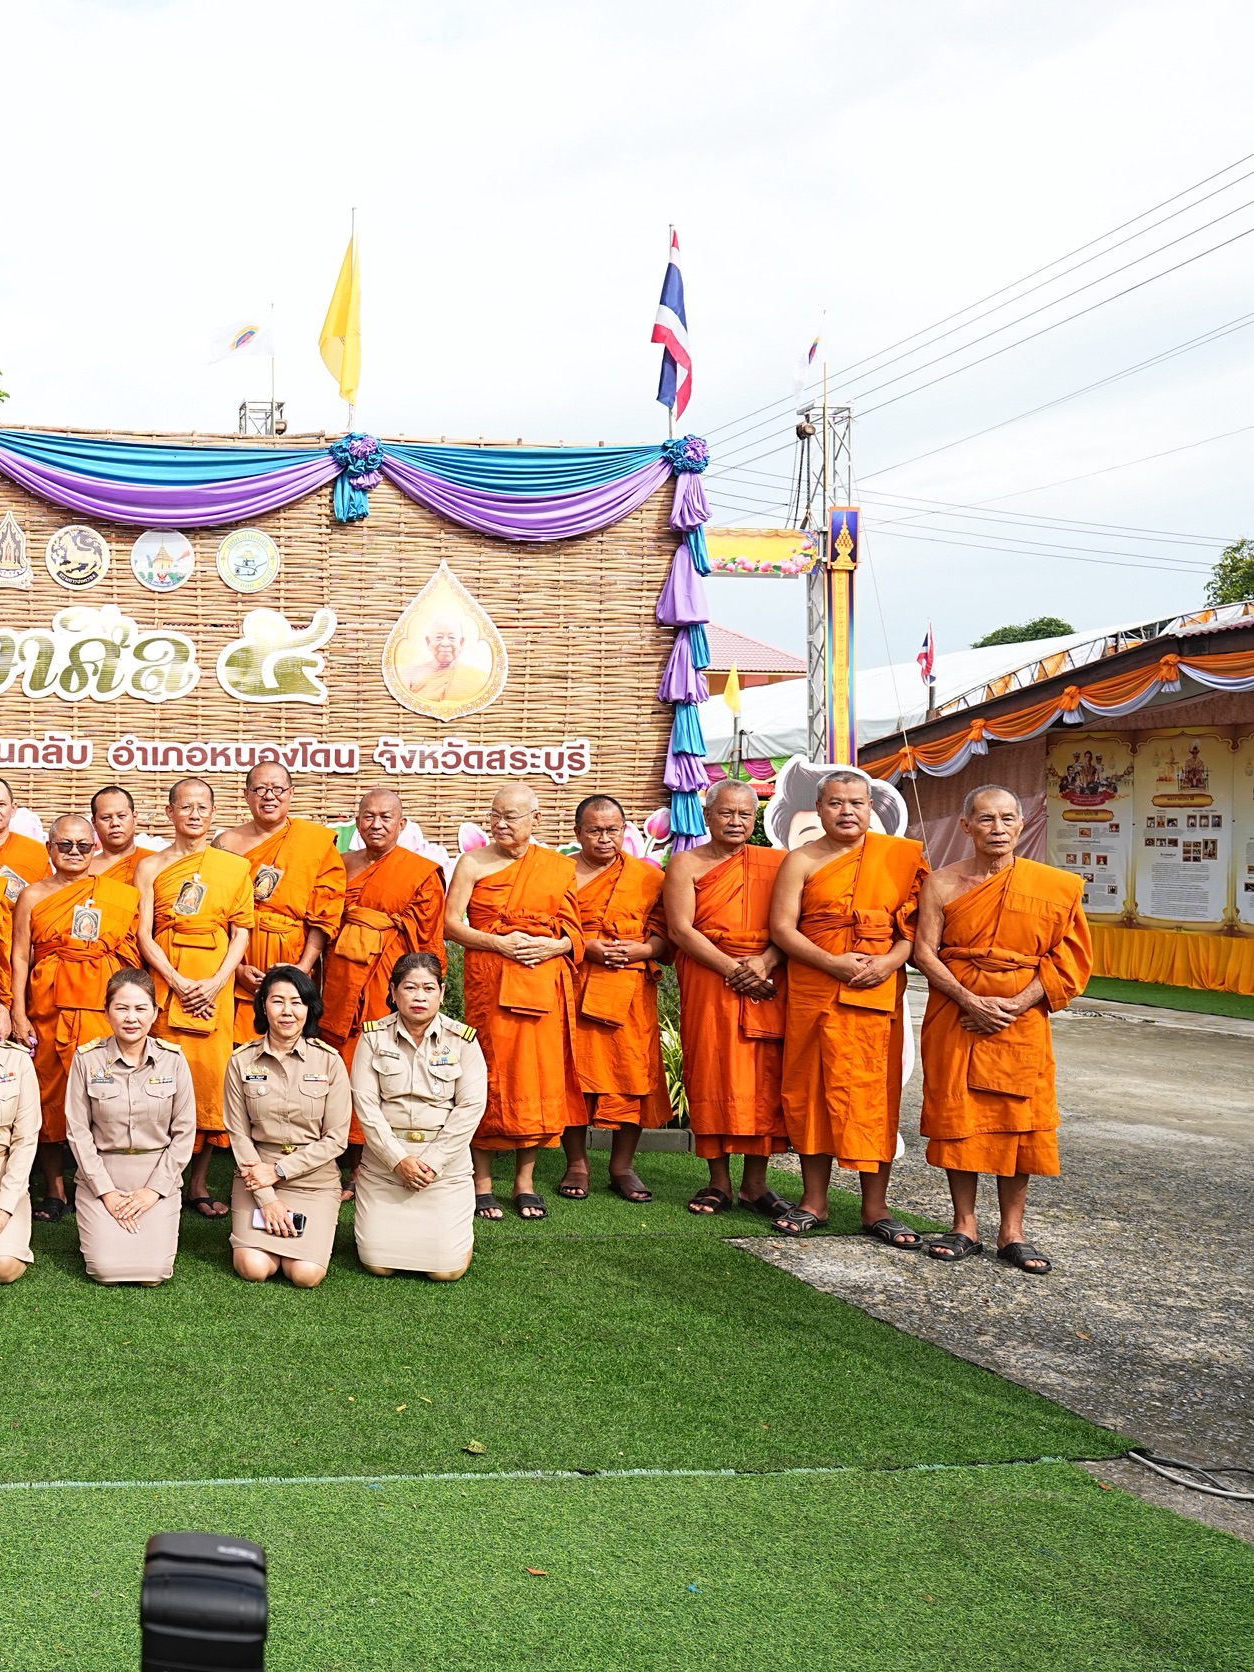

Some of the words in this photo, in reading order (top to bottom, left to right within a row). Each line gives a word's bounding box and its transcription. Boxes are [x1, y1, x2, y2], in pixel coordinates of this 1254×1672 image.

[225, 616, 330, 697] ๕
[112, 739, 355, 768] อำเภอหนองโดน
[378, 741, 586, 779] จังหวัดสระบุรี
